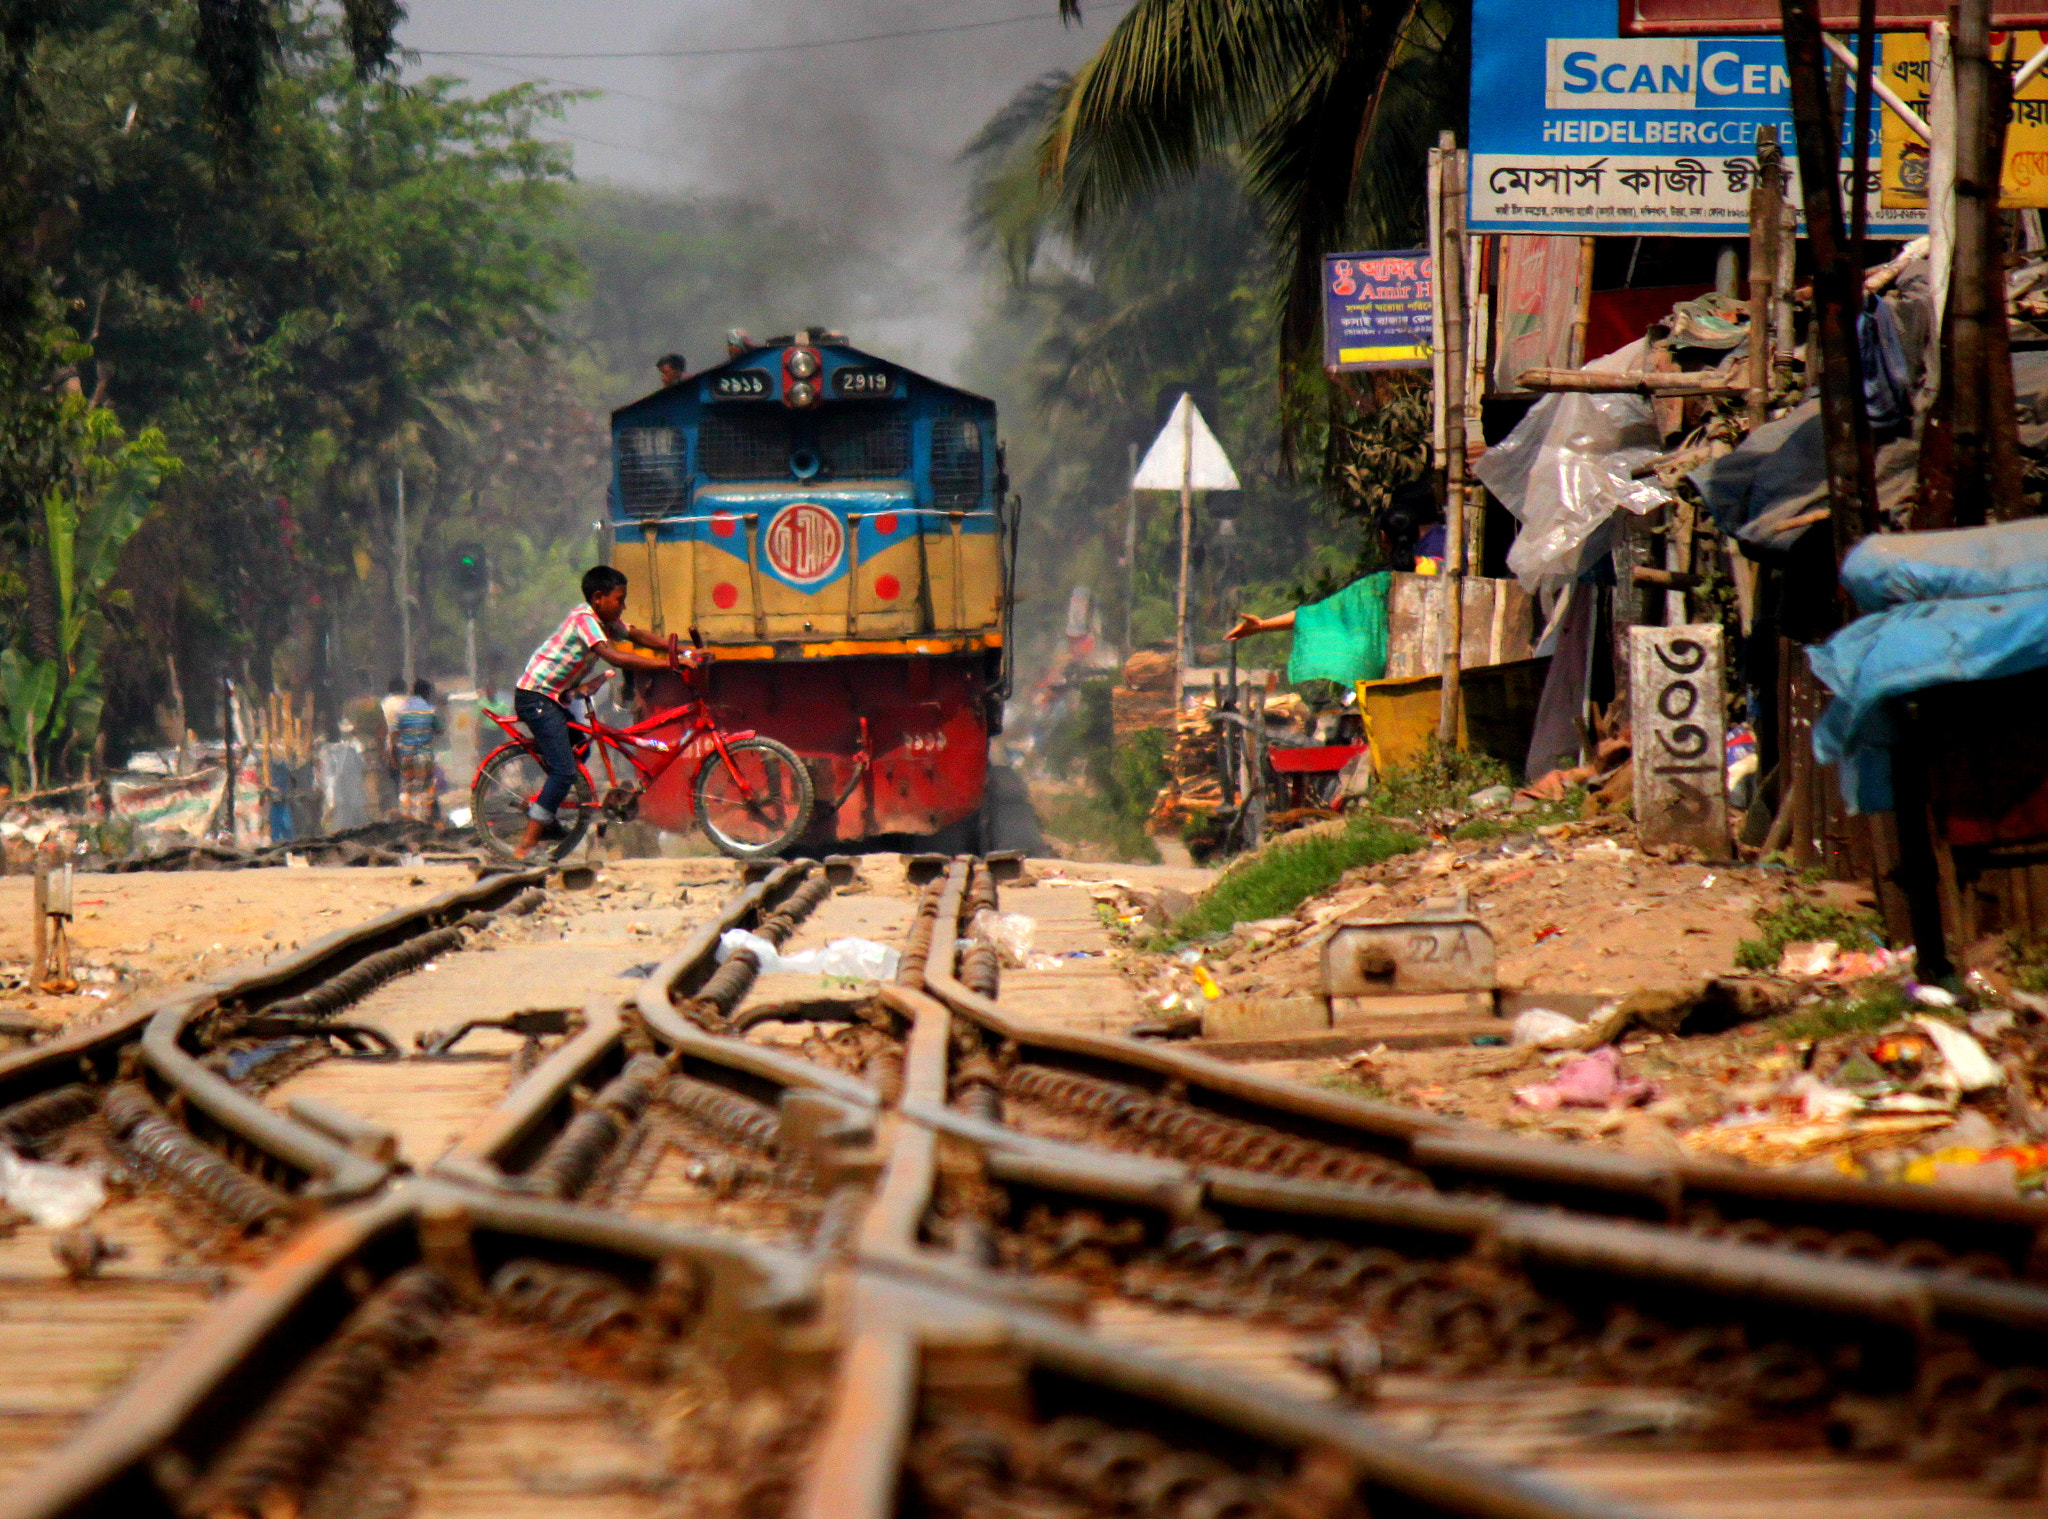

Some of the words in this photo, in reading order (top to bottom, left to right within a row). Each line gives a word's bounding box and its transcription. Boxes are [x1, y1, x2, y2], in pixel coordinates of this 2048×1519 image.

[1489, 157, 1610, 196] মেসার্স
[1615, 157, 1714, 197] কাজী
[1358, 281, 1412, 301] Amir
[843, 373, 887, 390] 2919
